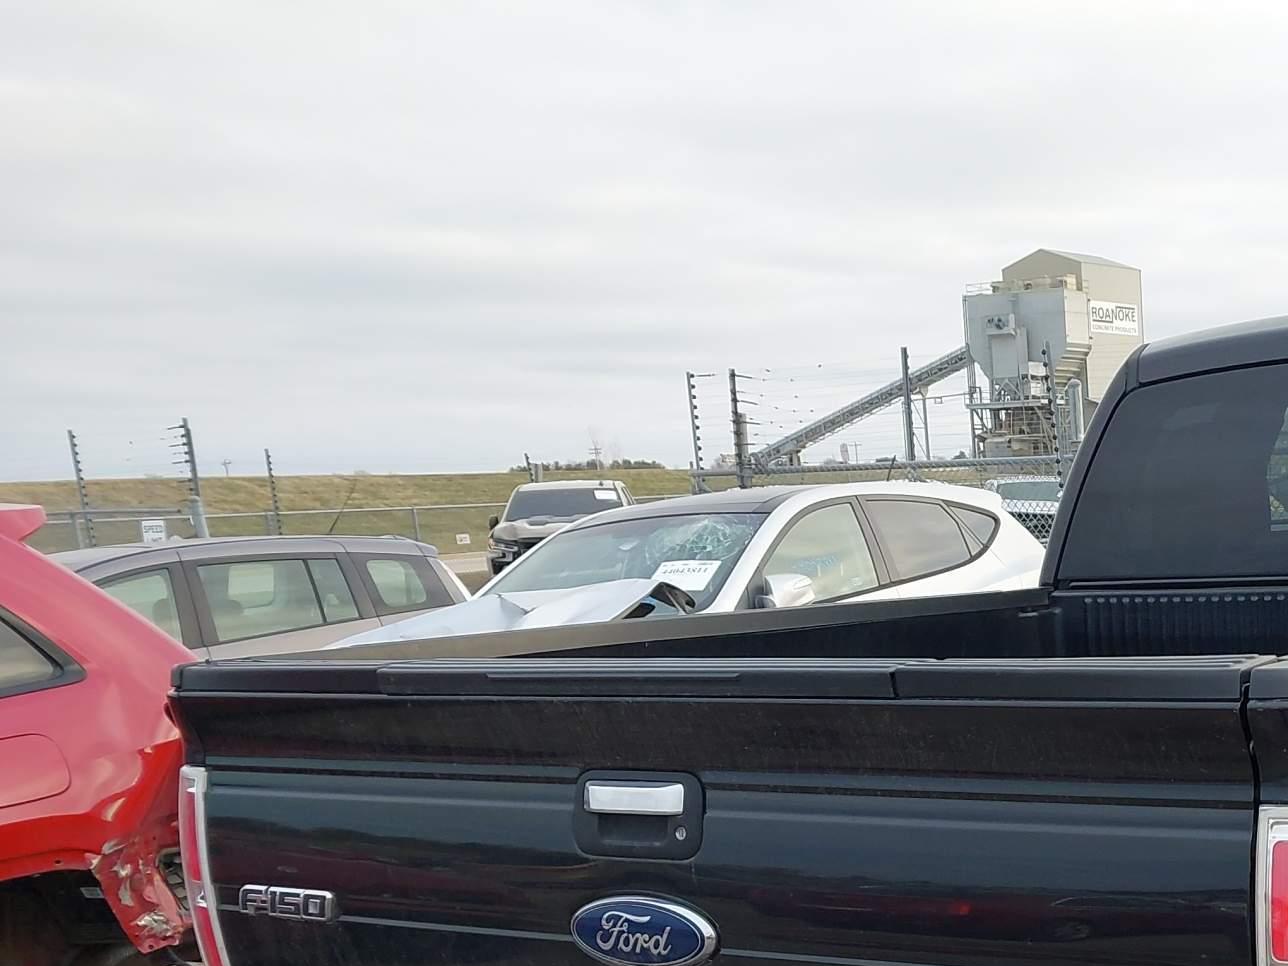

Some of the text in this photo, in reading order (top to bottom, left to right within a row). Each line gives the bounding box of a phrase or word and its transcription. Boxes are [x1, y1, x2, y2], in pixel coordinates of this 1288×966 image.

[1091, 306, 1136, 323] ROANOKE
[240, 884, 335, 920] F-150
[596, 911, 672, 955] Ford
